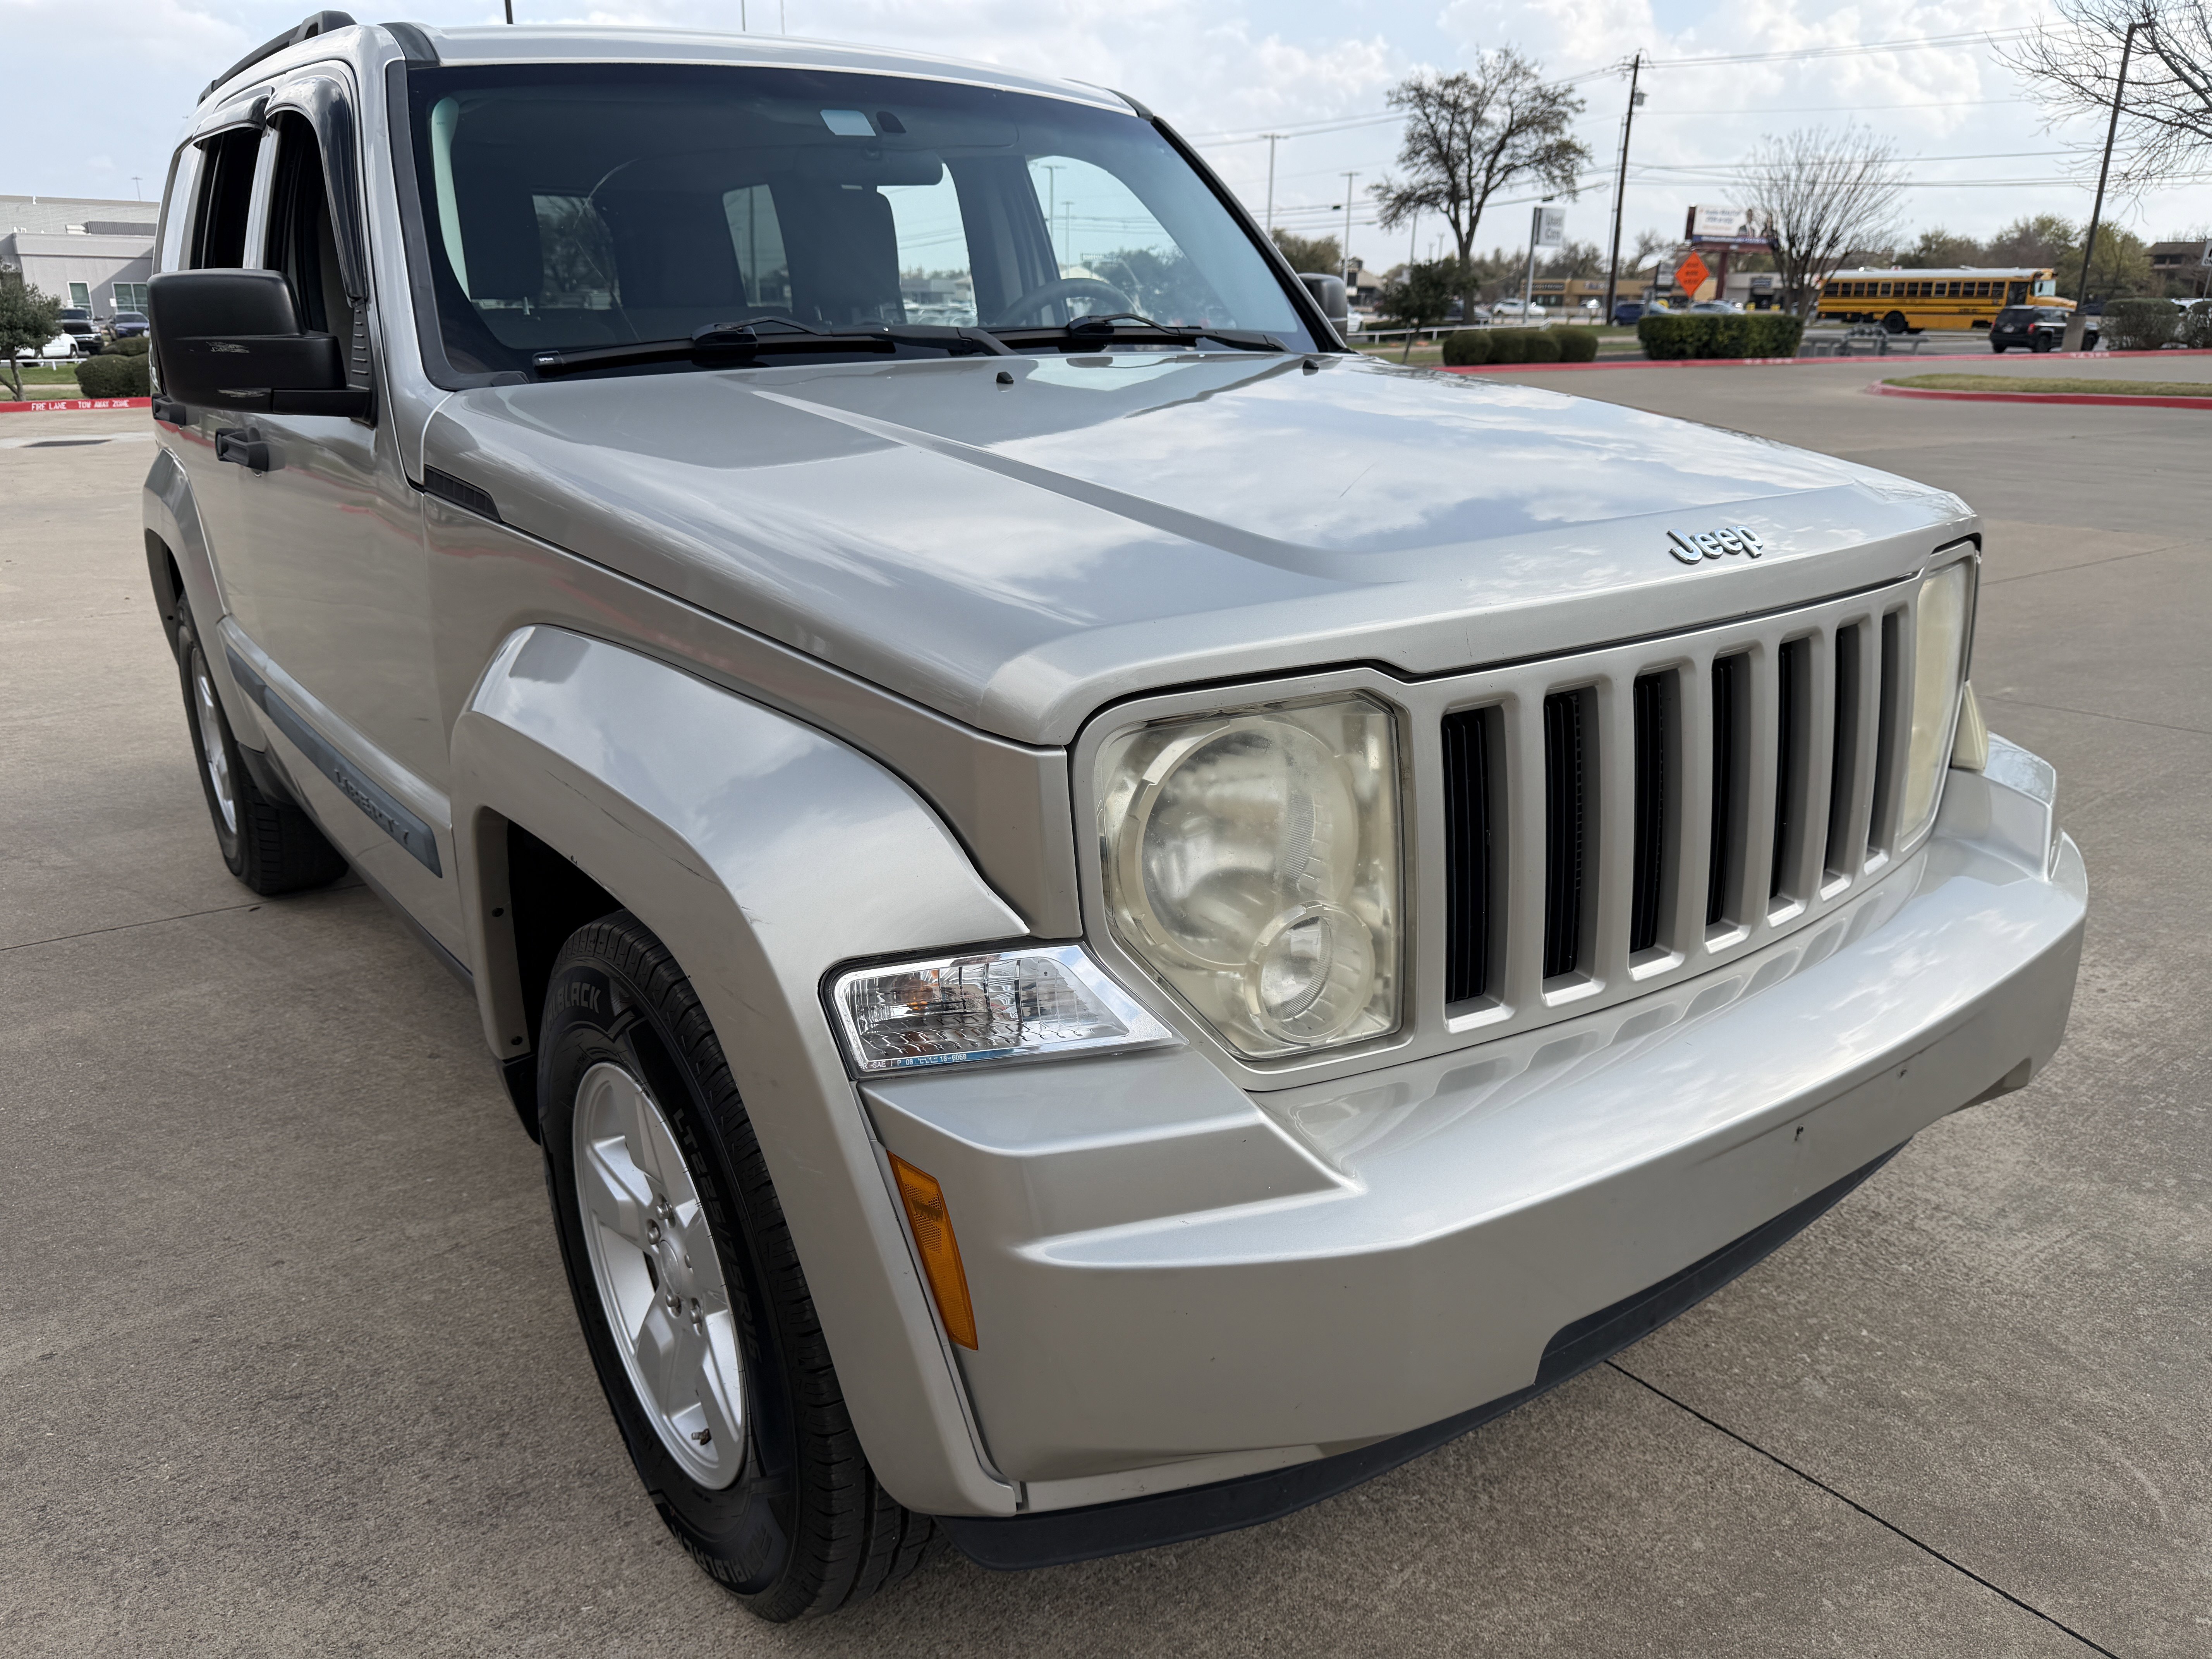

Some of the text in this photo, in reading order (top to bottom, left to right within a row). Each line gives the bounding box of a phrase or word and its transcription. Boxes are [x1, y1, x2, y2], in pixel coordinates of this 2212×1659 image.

[31, 402, 46, 411] FIRE
[48, 402, 67, 410] LANE
[78, 400, 91, 409] TOW
[112, 399, 129, 407] ZONE
[1666, 525, 1763, 565] Jeep
[557, 982, 601, 1014] BLACK
